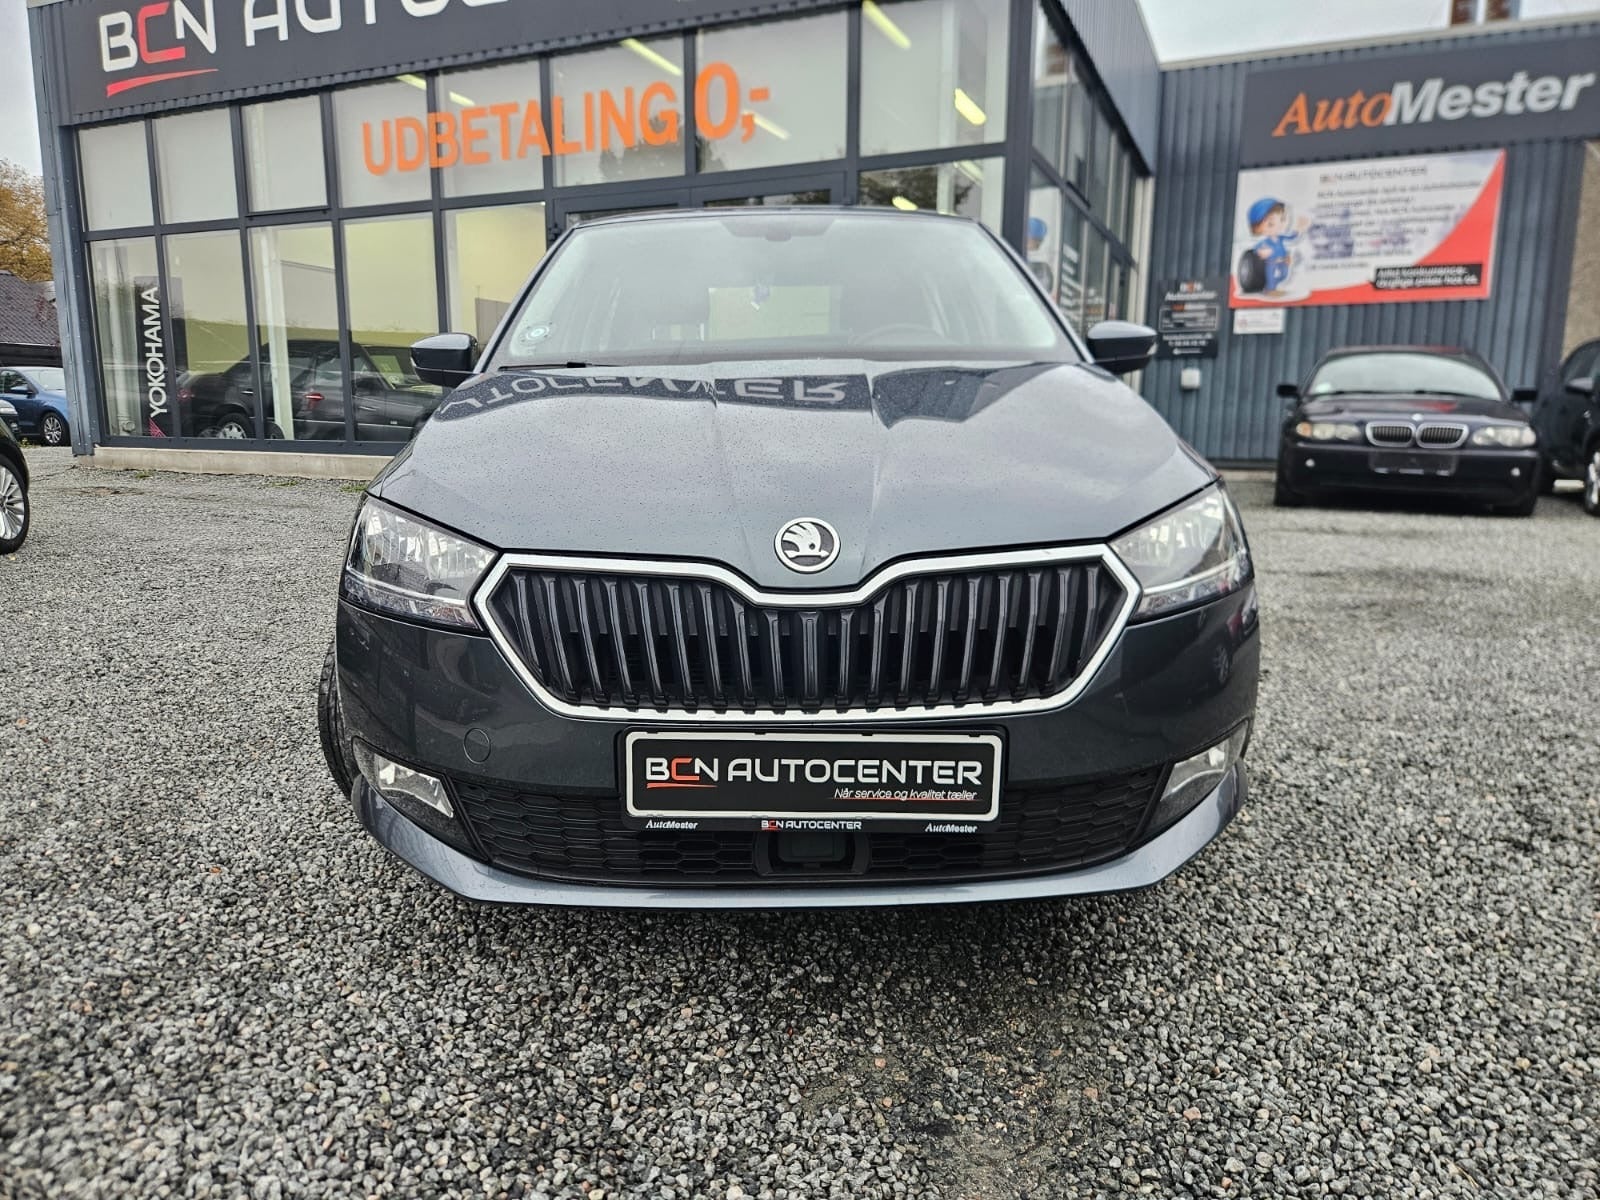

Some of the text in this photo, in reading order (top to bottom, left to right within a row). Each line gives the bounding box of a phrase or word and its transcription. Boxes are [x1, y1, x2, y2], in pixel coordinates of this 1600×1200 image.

[99, 0, 216, 72] BCN
[1271, 70, 1597, 137] AutoMester
[362, 81, 680, 177] UDBETALING
[141, 286, 168, 418] YOKOHAMA
[645, 755, 983, 785] BCN AUTOCENTER
[834, 787, 978, 801] Når service og kvalitet tæller
[645, 820, 698, 830] AutoMester
[761, 819, 862, 830] BCN AUTOCENTER
[925, 823, 978, 833] AutoMester
